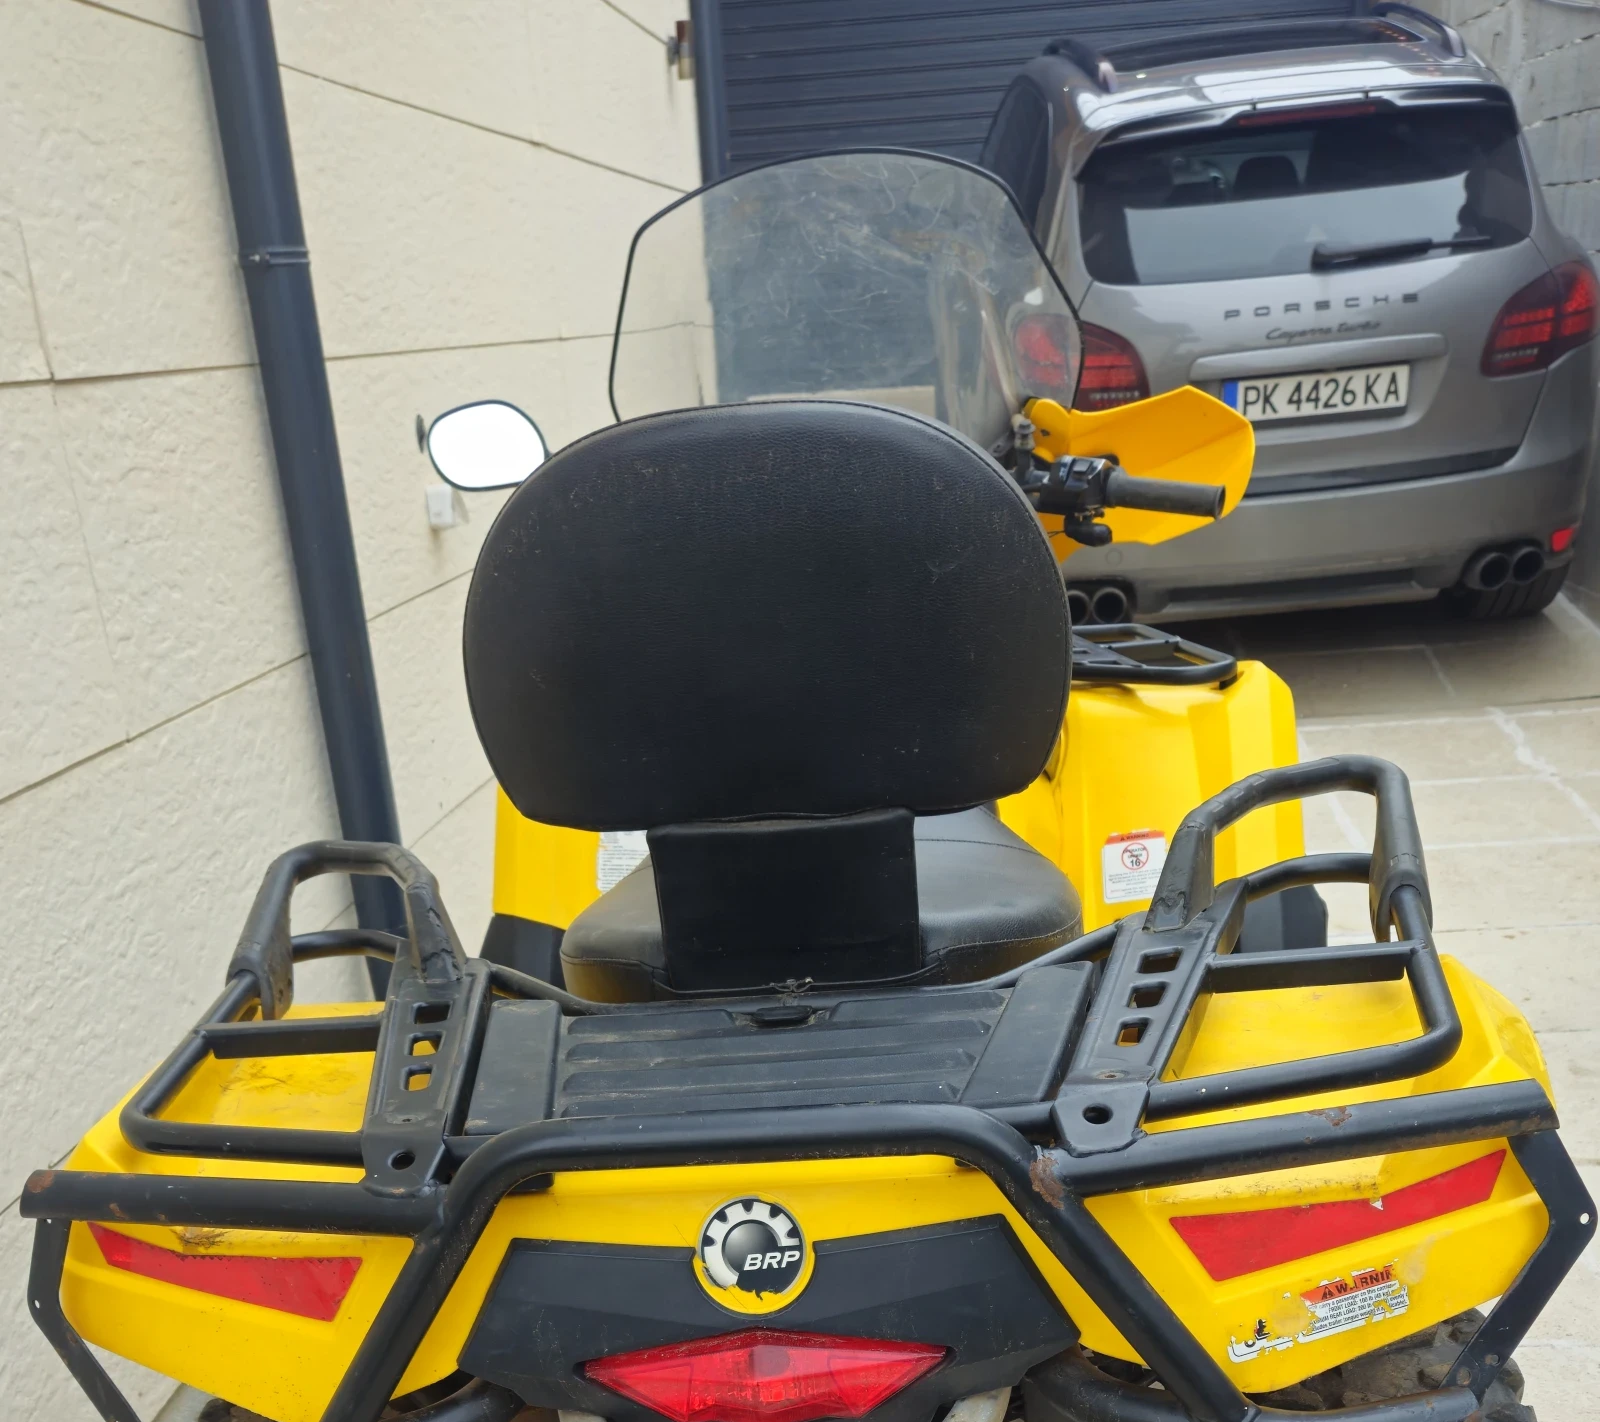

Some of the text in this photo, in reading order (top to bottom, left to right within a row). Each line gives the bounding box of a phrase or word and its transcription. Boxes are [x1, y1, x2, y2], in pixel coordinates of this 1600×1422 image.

[1224, 293, 1419, 320] PORSCHE
[1266, 327, 1333, 344] Cayenne
[1242, 371, 1400, 416] PK 4426 KA
[1130, 859, 1141, 868] 16
[743, 1250, 801, 1271] BRP
